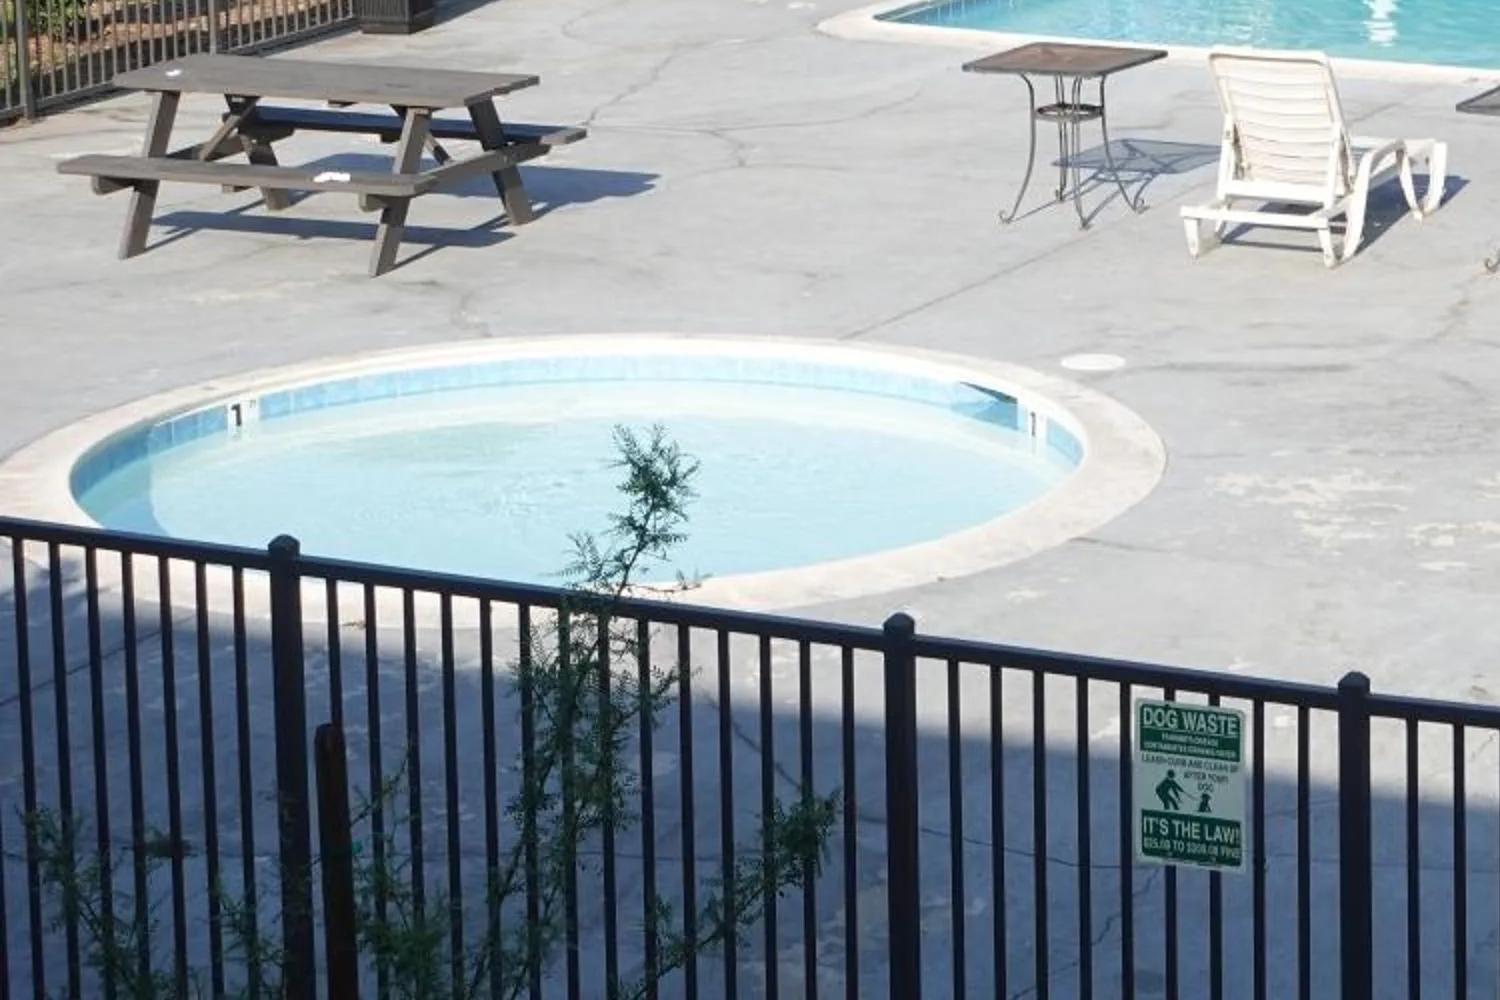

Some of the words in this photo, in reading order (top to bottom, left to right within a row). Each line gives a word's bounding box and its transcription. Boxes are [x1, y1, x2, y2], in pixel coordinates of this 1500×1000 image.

[231, 403, 242, 426] 1
[1143, 707, 1178, 728] DOG
[1182, 711, 1237, 735] WASTE
[1143, 817, 1168, 836] IT'S
[1171, 819, 1200, 840] THE
[1204, 824, 1240, 844] LAW!
[1172, 839, 1185, 853] TO
